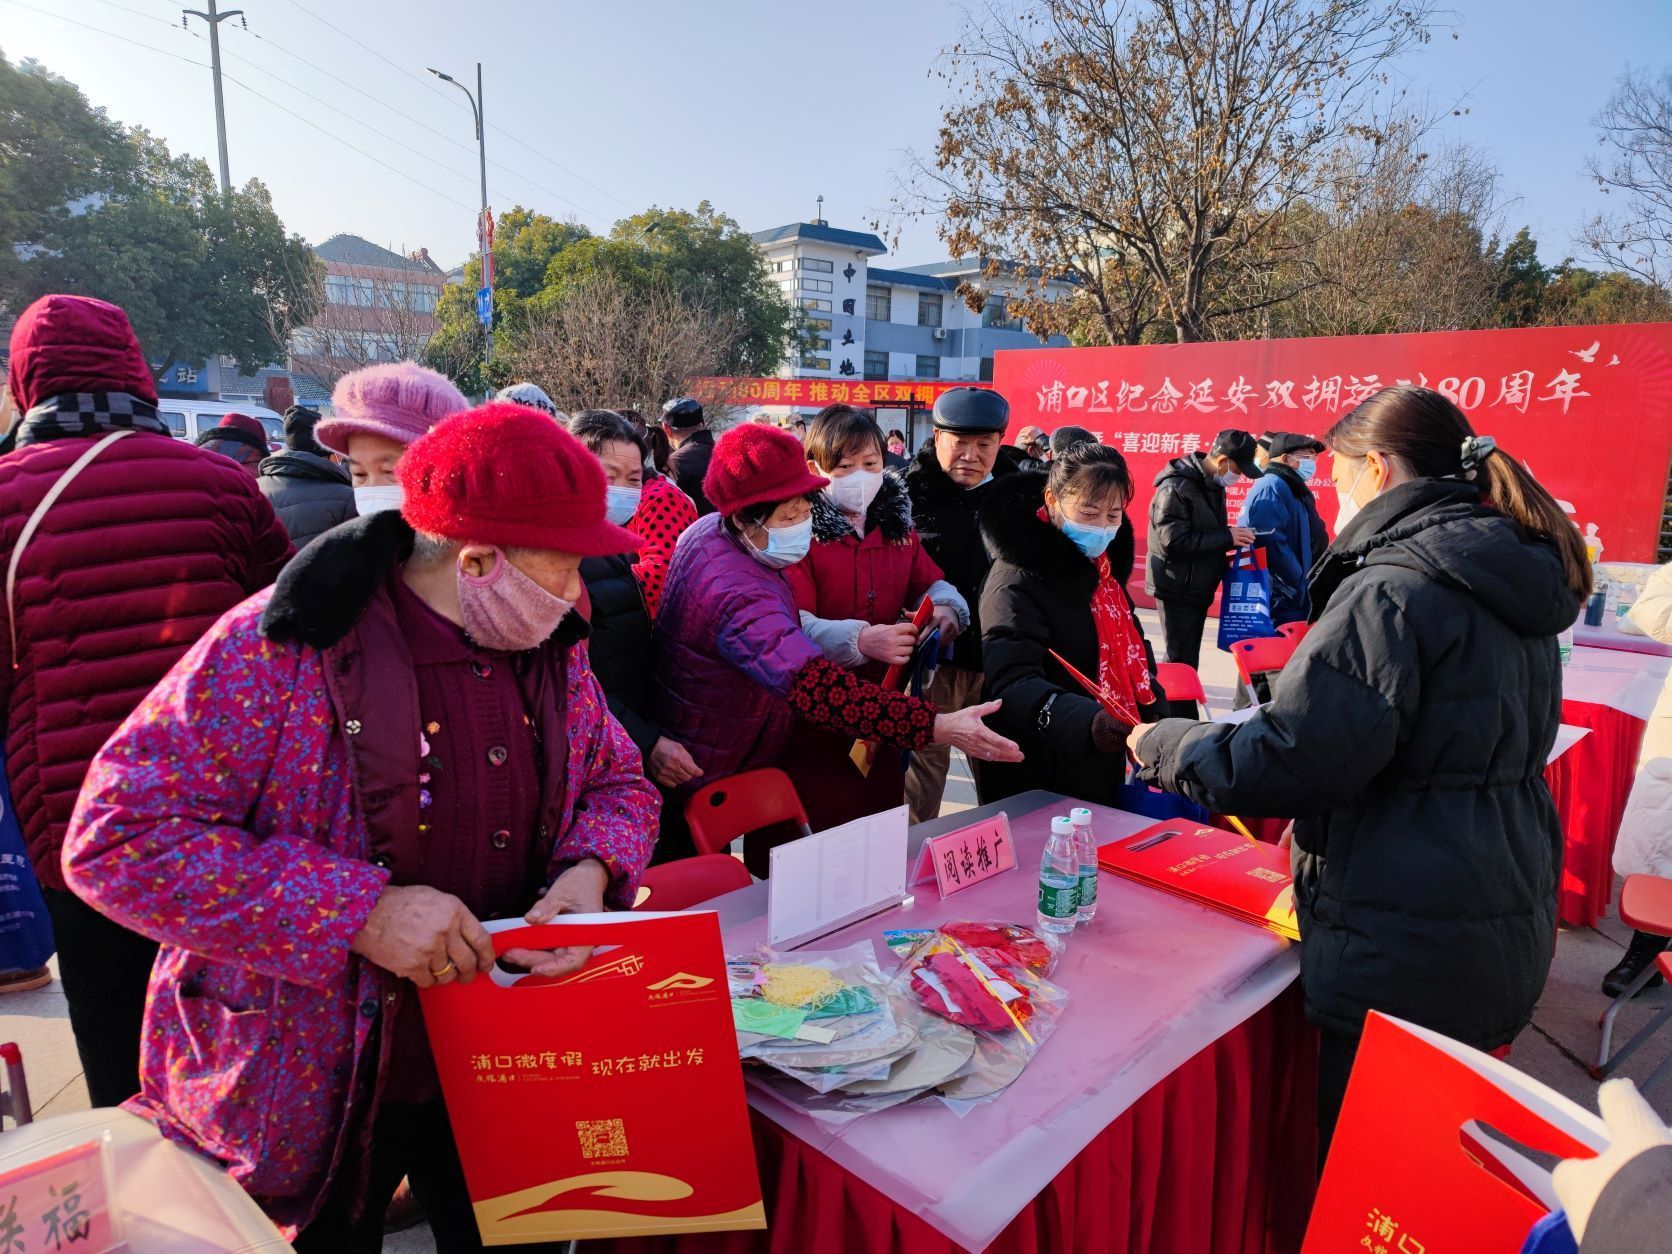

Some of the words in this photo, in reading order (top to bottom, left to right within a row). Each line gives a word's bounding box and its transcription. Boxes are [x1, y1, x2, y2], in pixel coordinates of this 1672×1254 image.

[839, 262, 862, 376] 中国土地
[809, 381, 945, 404] 推动全区双拥
[1036, 368, 1592, 416] 浦口区纪念延安双拥运80周年
[1114, 431, 1219, 454] “喜迎新春·
[943, 829, 1003, 884] 阅读推广
[470, 1050, 583, 1070] 浦口微度假
[592, 1048, 704, 1076] 现在就出发
[1366, 1207, 1425, 1254] 浦口
